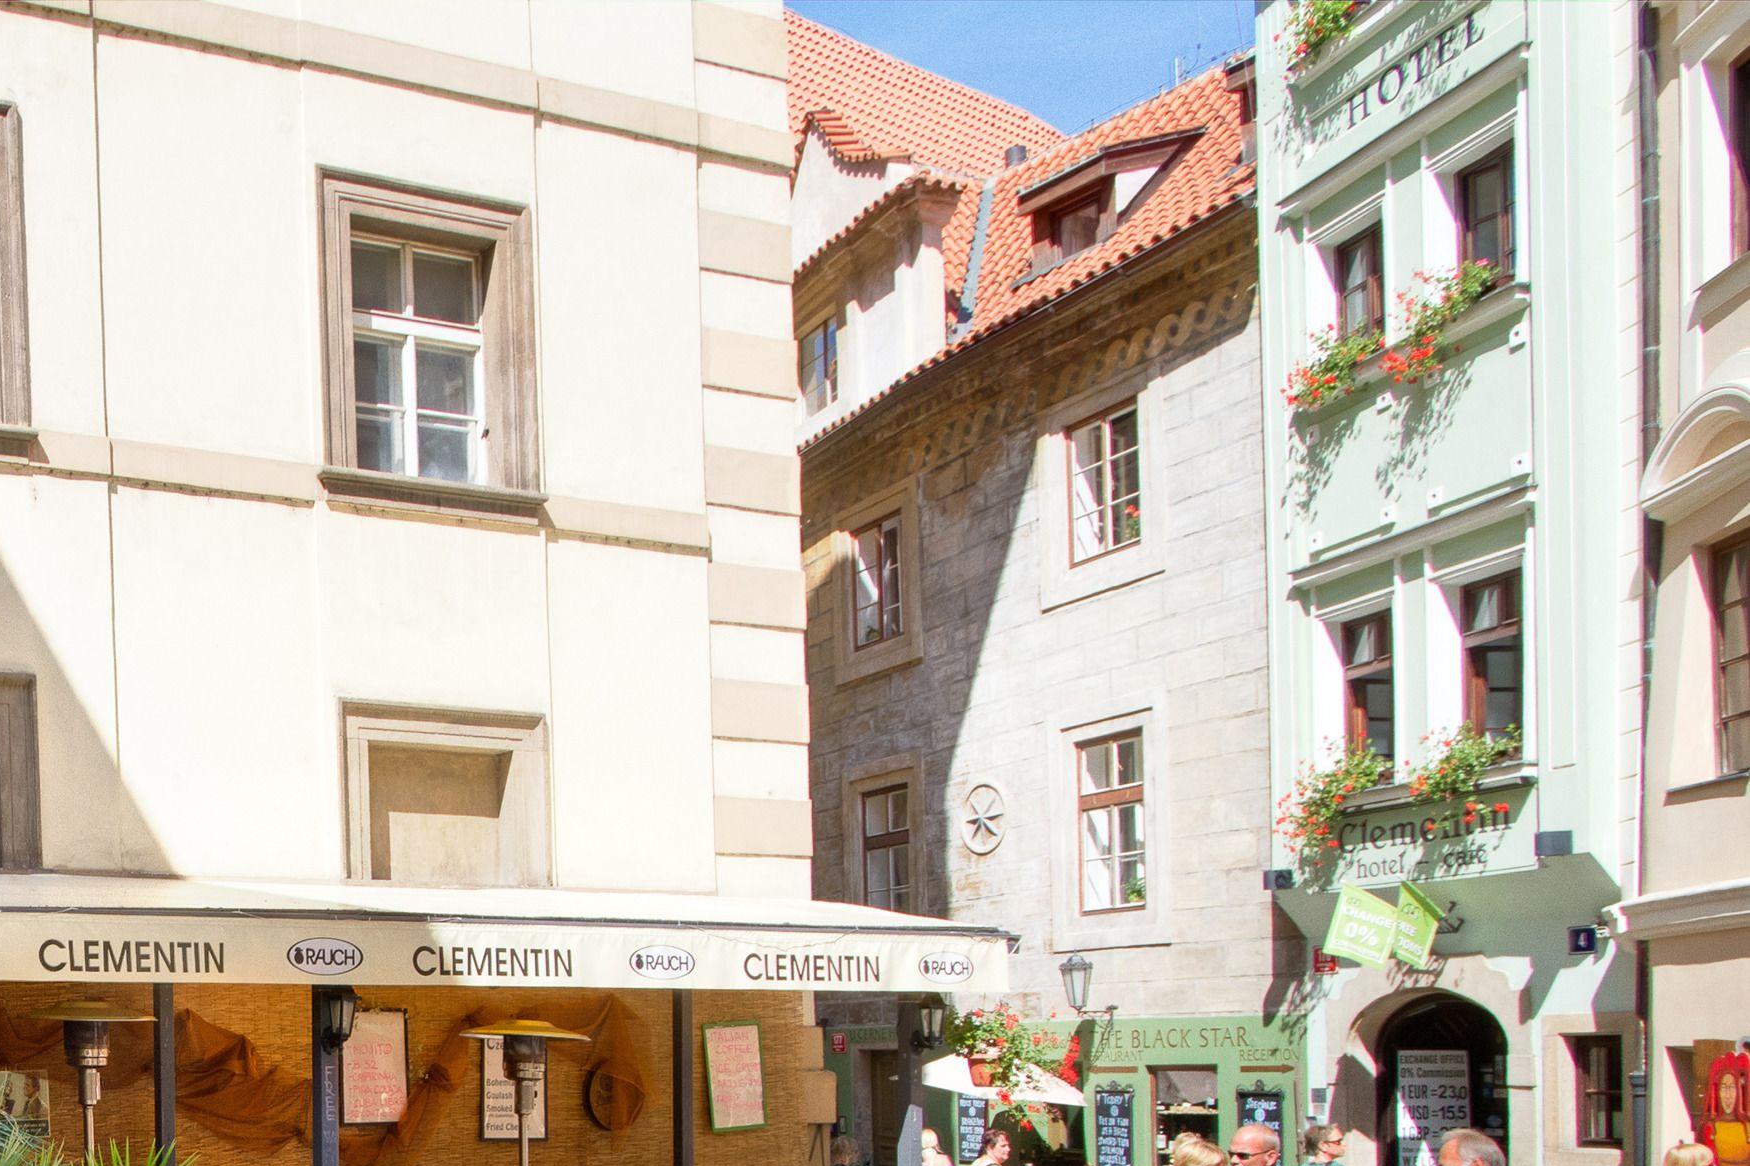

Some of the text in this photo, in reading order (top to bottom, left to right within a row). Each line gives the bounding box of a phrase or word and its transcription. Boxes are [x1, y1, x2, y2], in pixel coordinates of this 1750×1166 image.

[1347, 9, 1486, 130] HOTEL
[1356, 853, 1405, 879] hotel
[38, 938, 225, 974] CLEMENTIN
[305, 948, 357, 966] RAUCH
[412, 945, 573, 977] CLEMENTIN
[646, 955, 690, 972] RAUCH
[743, 953, 881, 983] CLEMENTIN
[931, 960, 970, 976] RAUCH
[1131, 1029, 1193, 1049] BLACK
[1199, 1026, 1249, 1048] STAR
[1238, 1047, 1300, 1062] RECEPTION
[1408, 1084, 1428, 1099] EUR
[485, 1103, 513, 1113] Smoked
[485, 1122, 504, 1131] Fried
